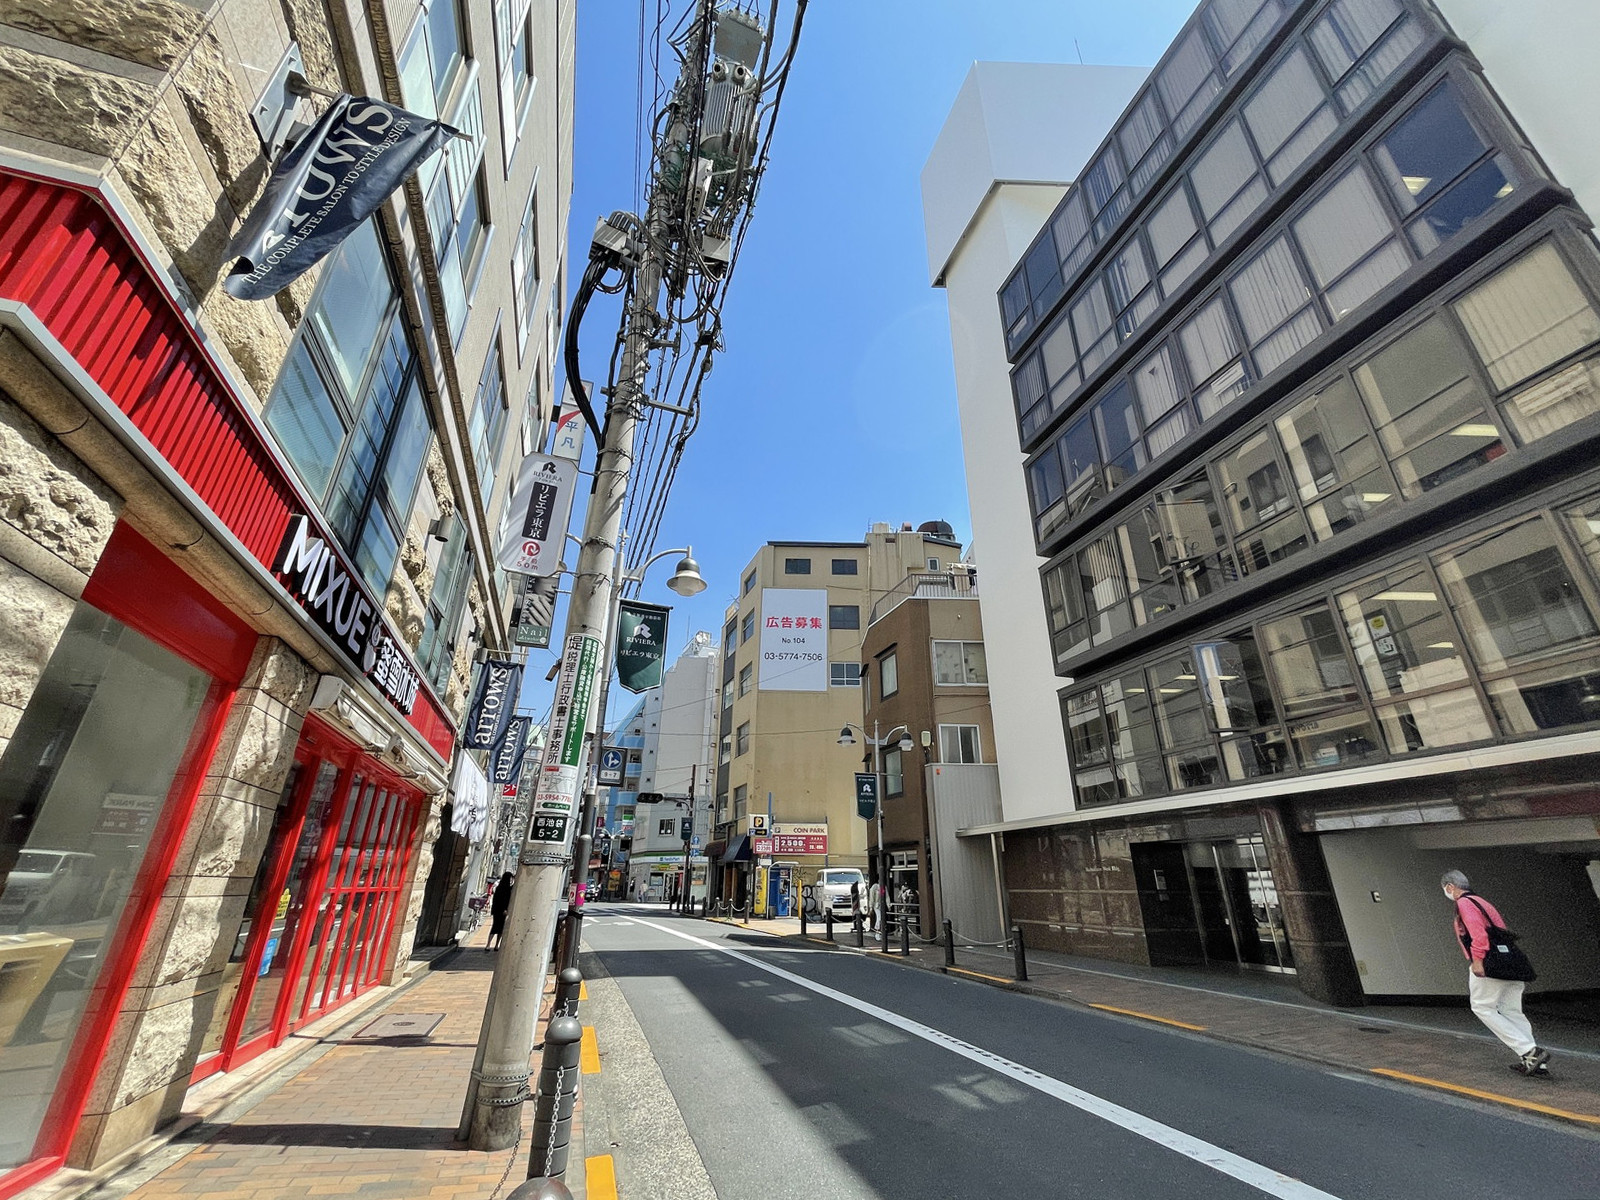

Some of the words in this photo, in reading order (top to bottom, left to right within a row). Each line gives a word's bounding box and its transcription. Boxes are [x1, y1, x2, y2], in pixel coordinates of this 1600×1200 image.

[241, 263, 272, 285] THE
[267, 214, 323, 265] COMPLETE
[317, 185, 349, 217] SALON
[343, 170, 361, 187] TO
[355, 145, 386, 176] STYLE
[380, 117, 412, 153] DESIGN
[561, 420, 578, 449] 平凡
[533, 470, 562, 482] RIVIERA
[529, 485, 550, 539] リビエラ東京
[283, 514, 372, 655] MIXUE
[766, 616, 822, 629] 広告募集
[520, 626, 548, 637] Nail
[626, 636, 657, 647] RIVIERA
[764, 652, 823, 661] 03-5774-7506
[475, 667, 508, 745] arrows
[495, 720, 520, 781] arrows
[537, 818, 564, 828] 西池袋
[538, 829, 559, 839] 5-2
